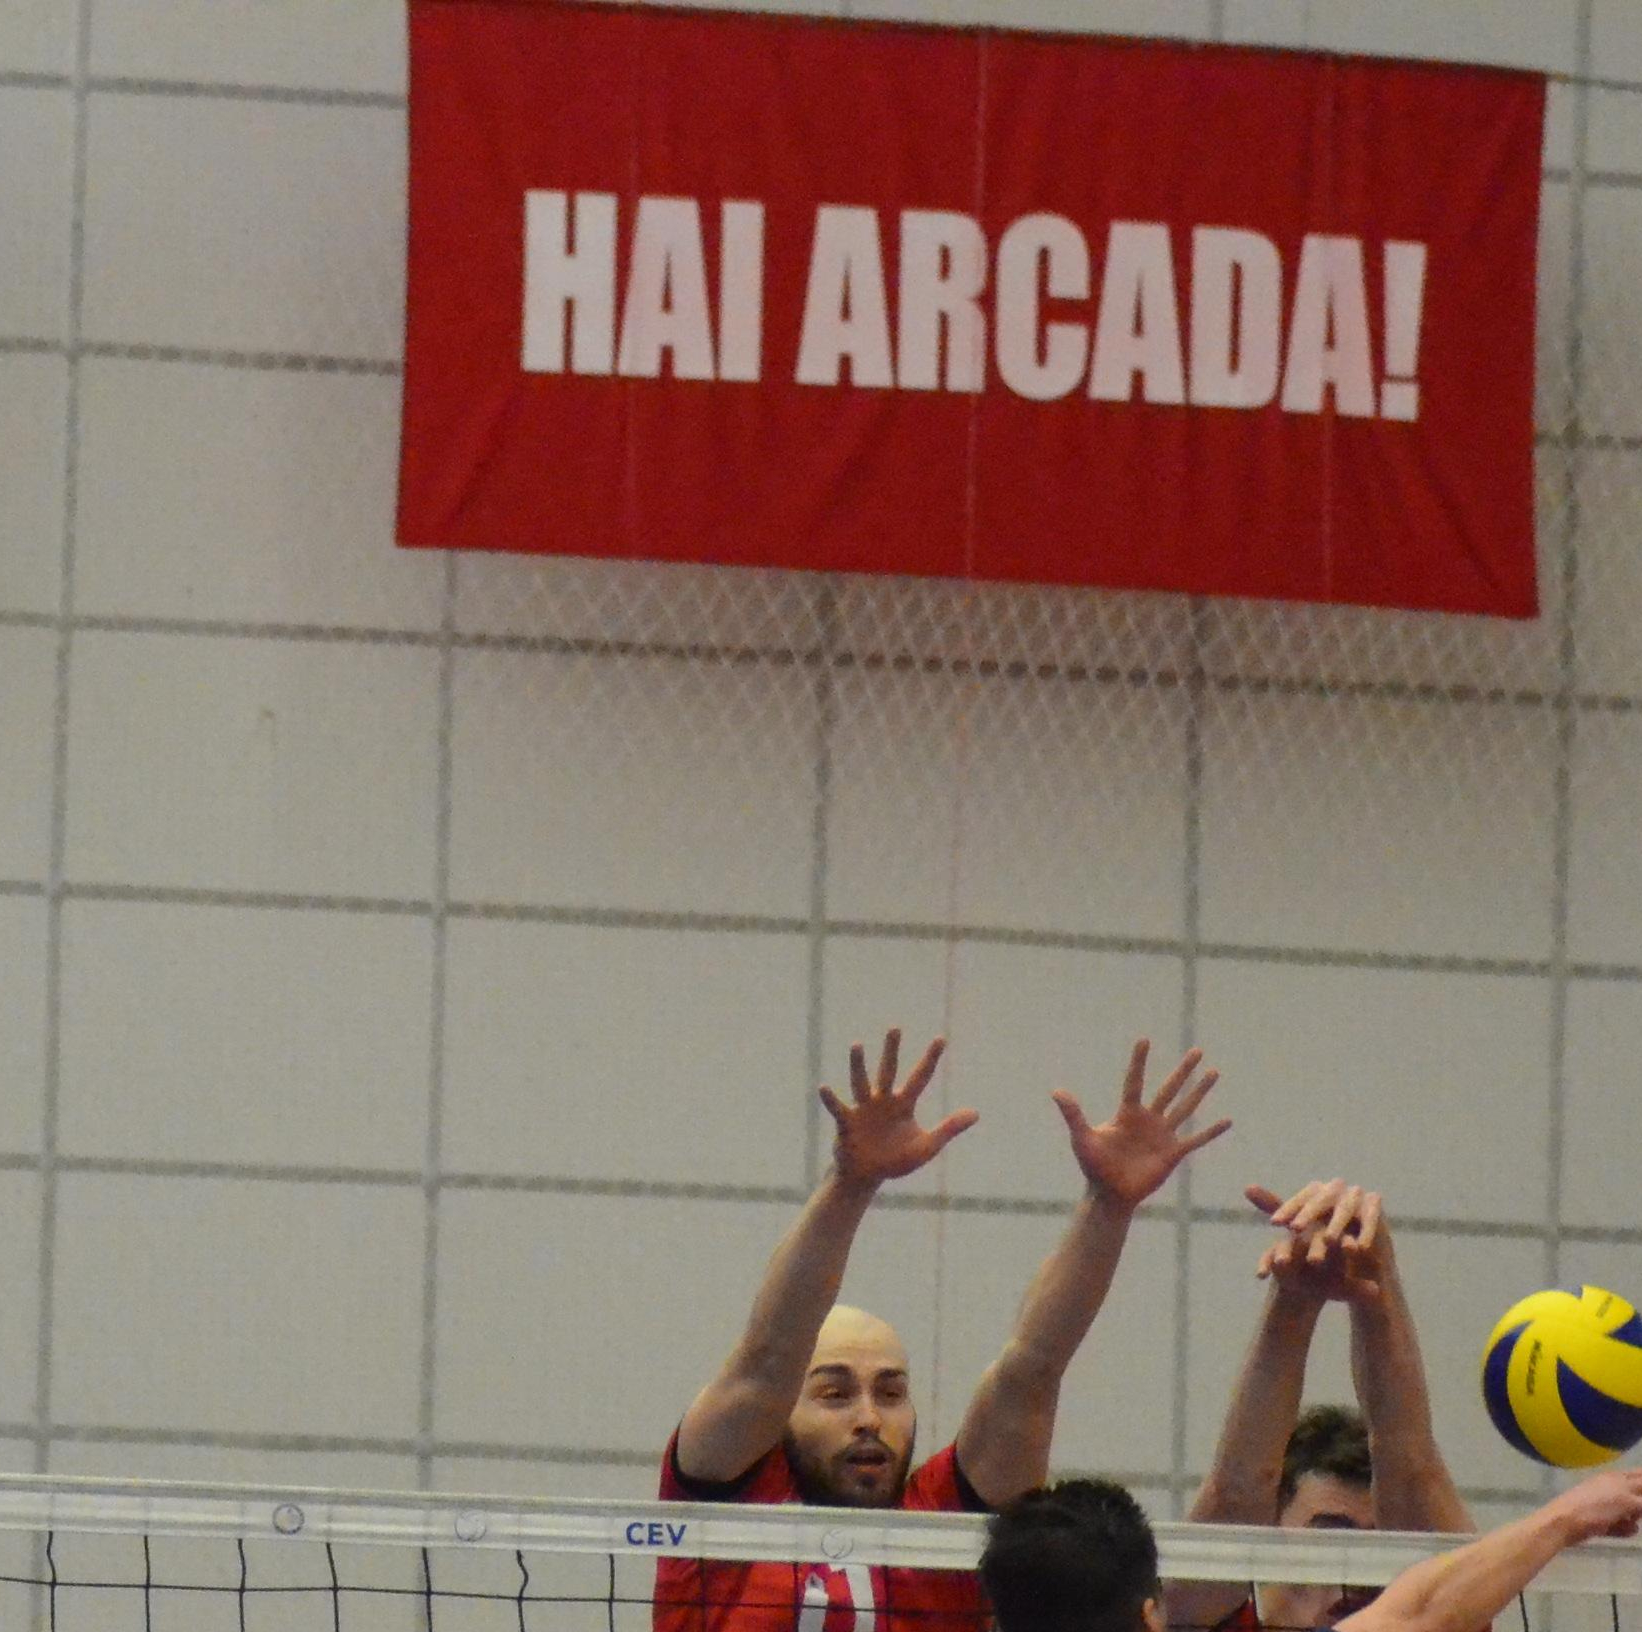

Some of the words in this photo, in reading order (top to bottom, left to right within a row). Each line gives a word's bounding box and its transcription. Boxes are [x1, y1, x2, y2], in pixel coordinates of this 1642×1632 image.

[521, 189, 764, 381] HAI
[795, 203, 1426, 422] ARCADA!
[624, 1521, 688, 1547] CEV
